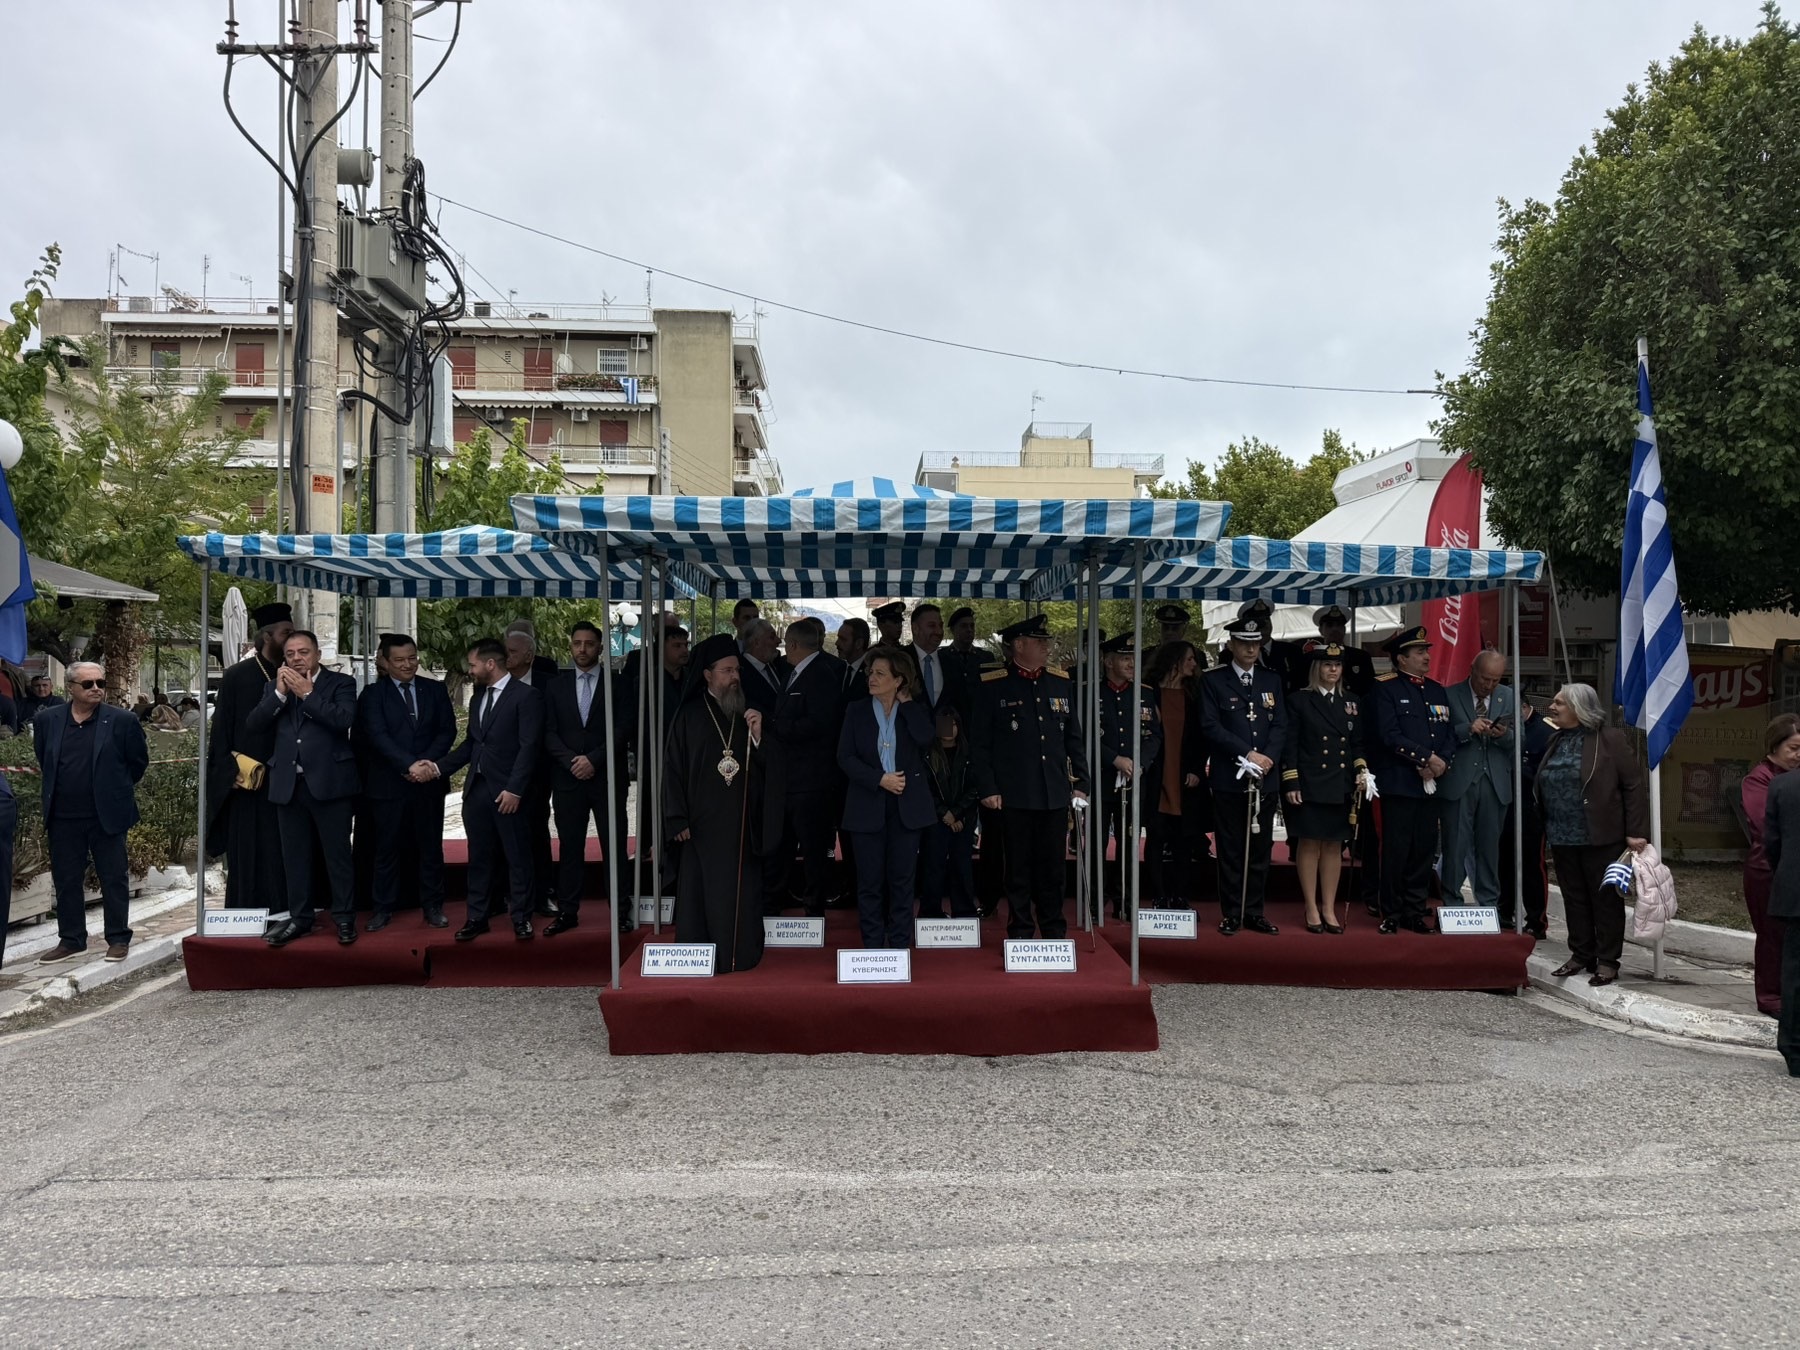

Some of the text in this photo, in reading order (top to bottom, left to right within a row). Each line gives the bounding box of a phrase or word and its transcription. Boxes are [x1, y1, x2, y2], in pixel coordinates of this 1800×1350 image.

[1376, 472, 1409, 490] FLAVOR SPOT
[1138, 912, 1192, 922] ΣΤΡΑΤΙΩΤΙΚΕΣ
[1442, 910, 1494, 918] ΑΠΟΣΤΡΑΤΟΙ
[206, 915, 264, 923] ΙΕΡΟΣ ΚΛΗΡΟΣ
[775, 921, 810, 929] ΔΗΜΑΡΧΟΣ
[1152, 922, 1178, 930] ΑΡΧΕΣ
[648, 948, 711, 957] ΜΗΤΡΟΠΟΛΙΤΗΣ
[1011, 944, 1070, 953] ΔΙΟΙΚΗΤΗΣ
[646, 959, 661, 967] Ι.Μ.
[851, 955, 899, 963] ΕΚΠΡΟΣΩΠΟΣ
[1010, 955, 1072, 963] ΣΥΝΤΑΓΜΑΤΟΣ
